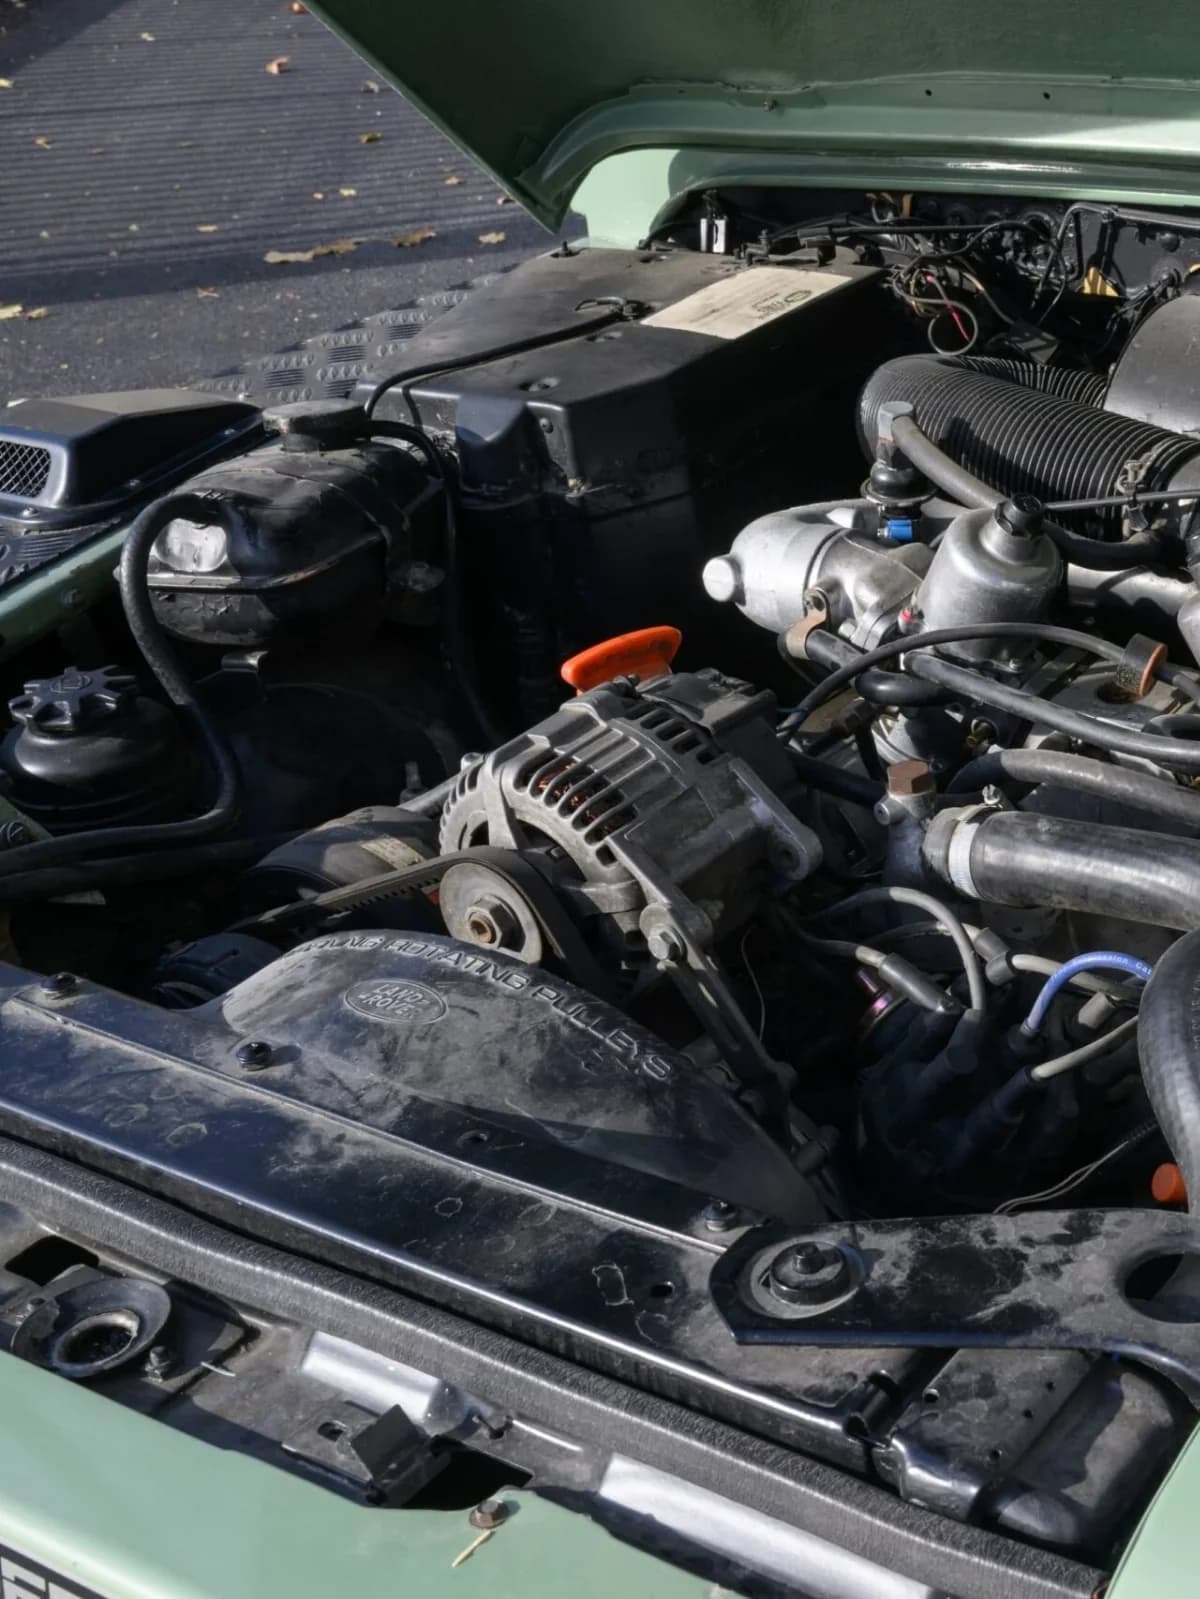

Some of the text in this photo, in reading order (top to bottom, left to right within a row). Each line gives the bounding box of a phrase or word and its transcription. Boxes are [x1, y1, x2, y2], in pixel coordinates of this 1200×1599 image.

[372, 983, 424, 1003] LAND
[383, 938, 532, 991] ROTATING
[531, 983, 673, 1082] PULLEYS
